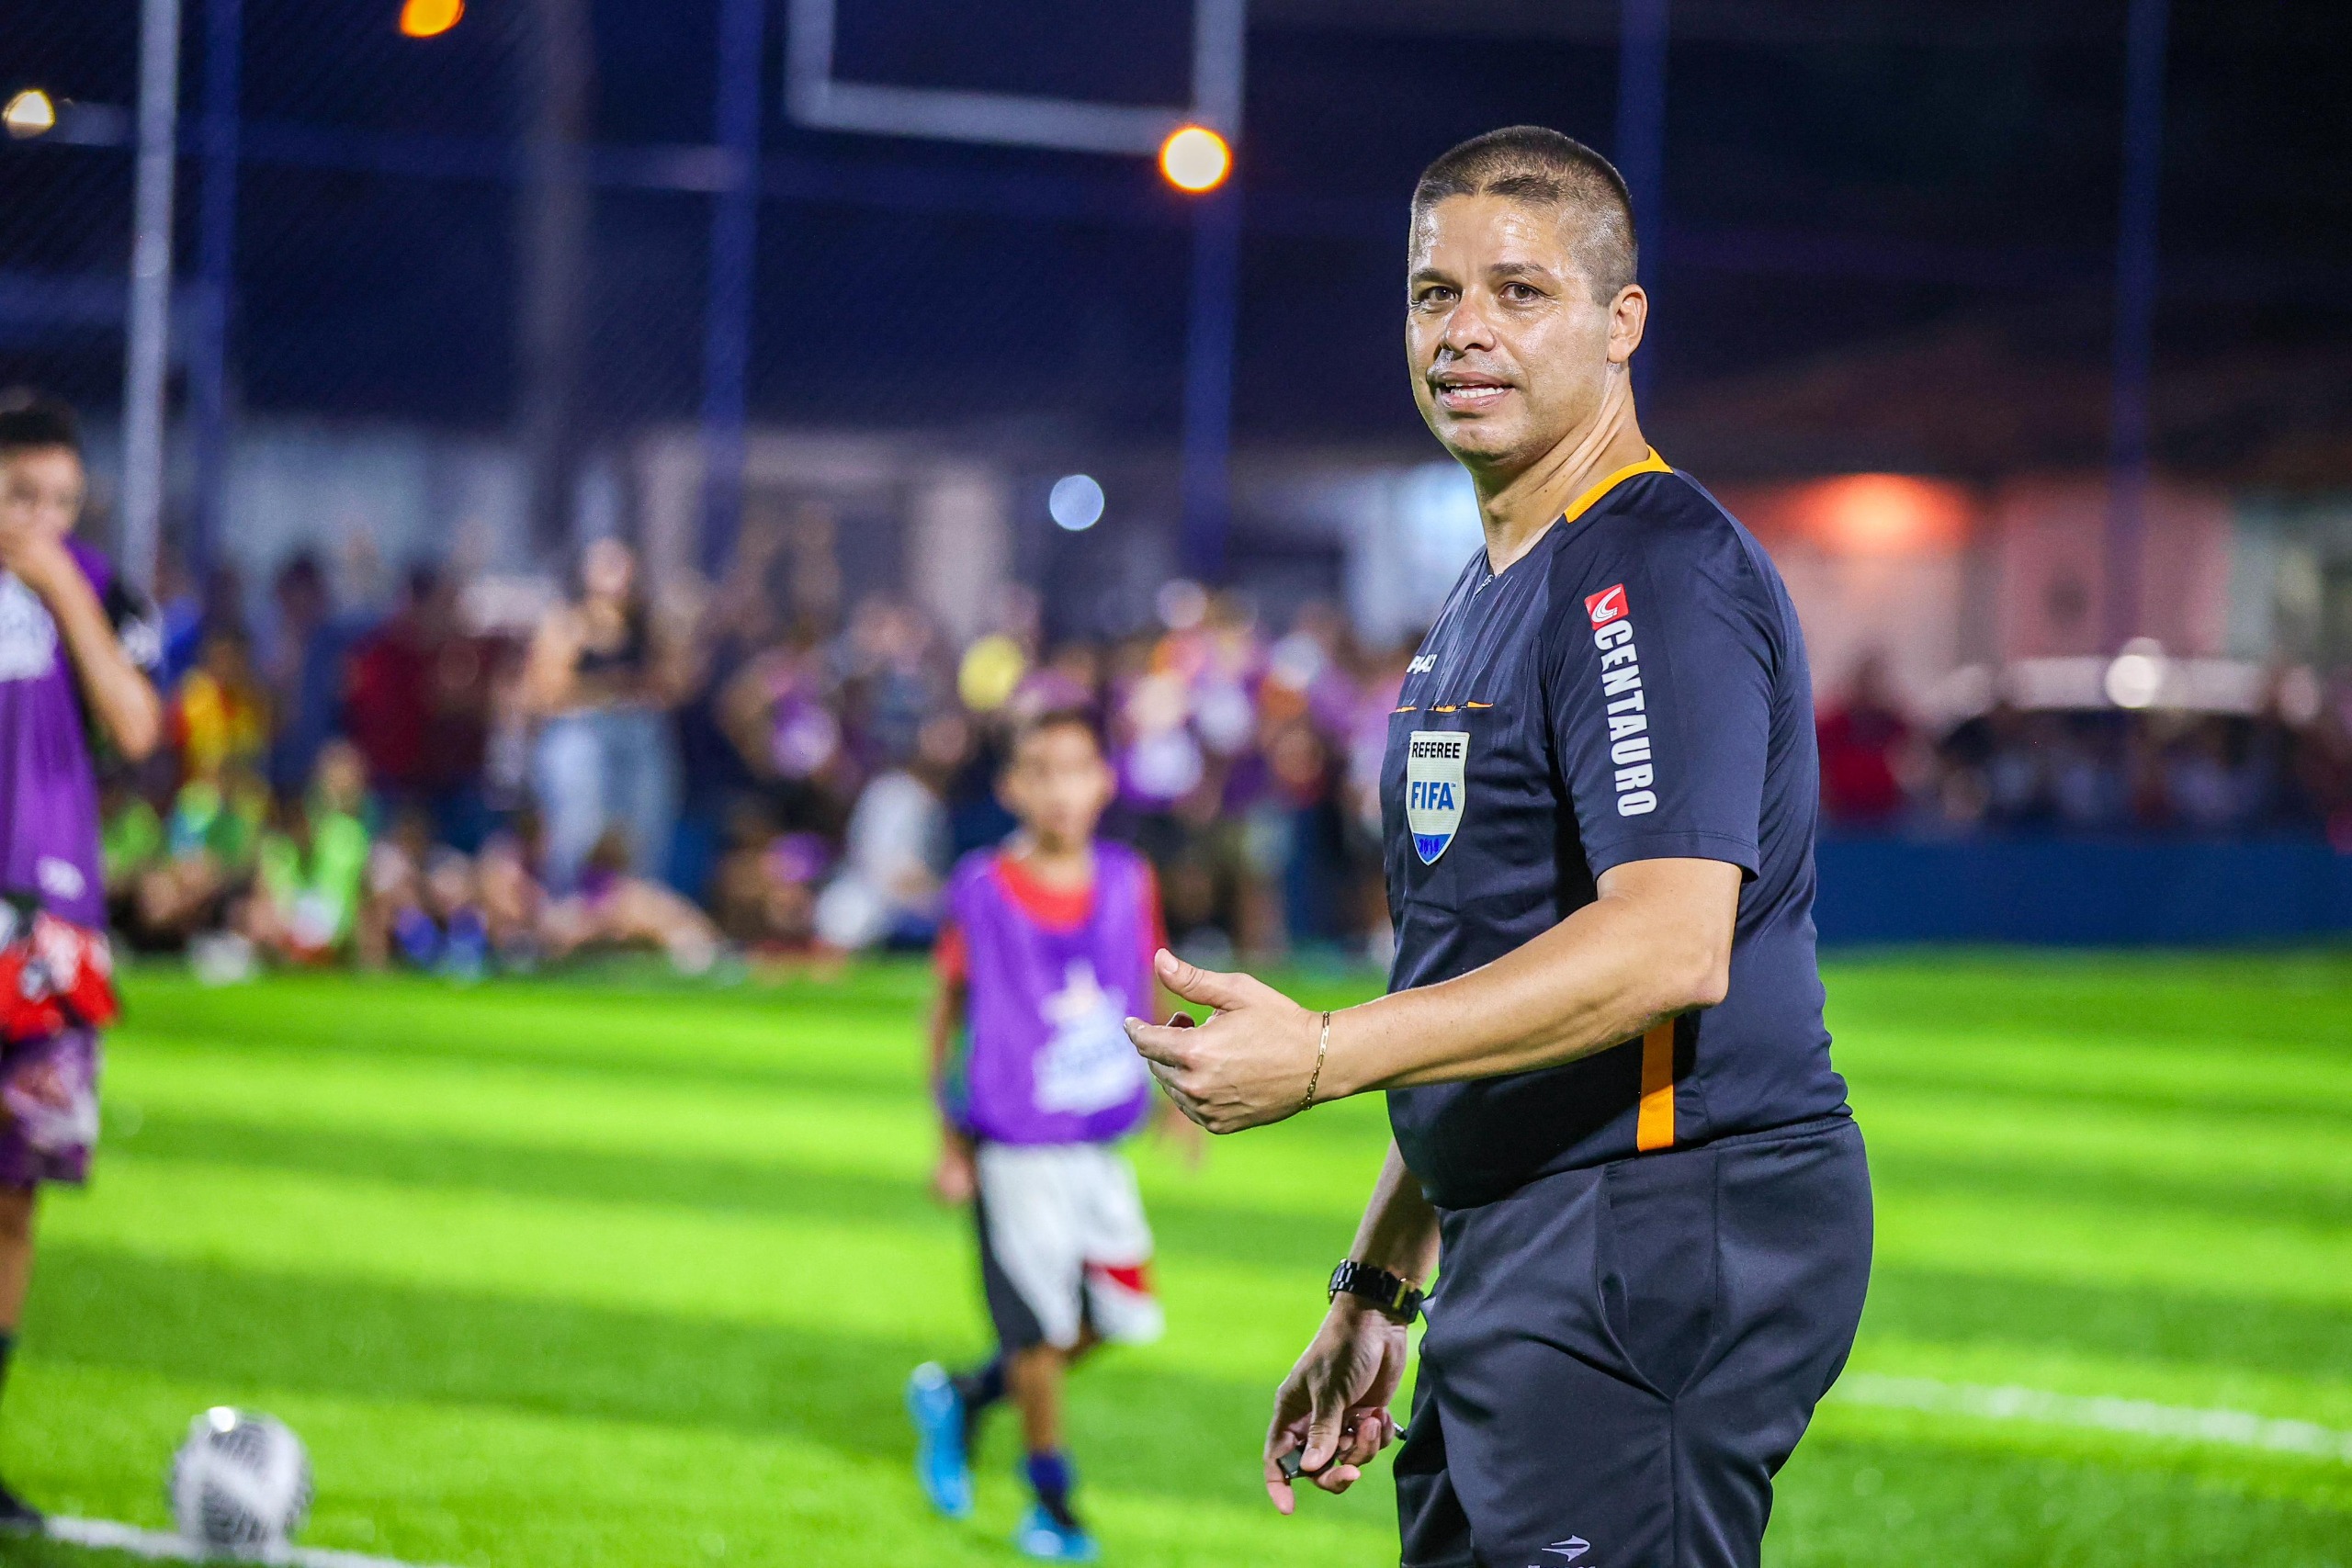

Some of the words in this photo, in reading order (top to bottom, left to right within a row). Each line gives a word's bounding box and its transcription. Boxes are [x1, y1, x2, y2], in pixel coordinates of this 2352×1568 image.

[1594, 619, 1657, 817] CENTAURO
[1412, 741, 1461, 759] REFEREE
[1411, 781, 1455, 810] FIFA
